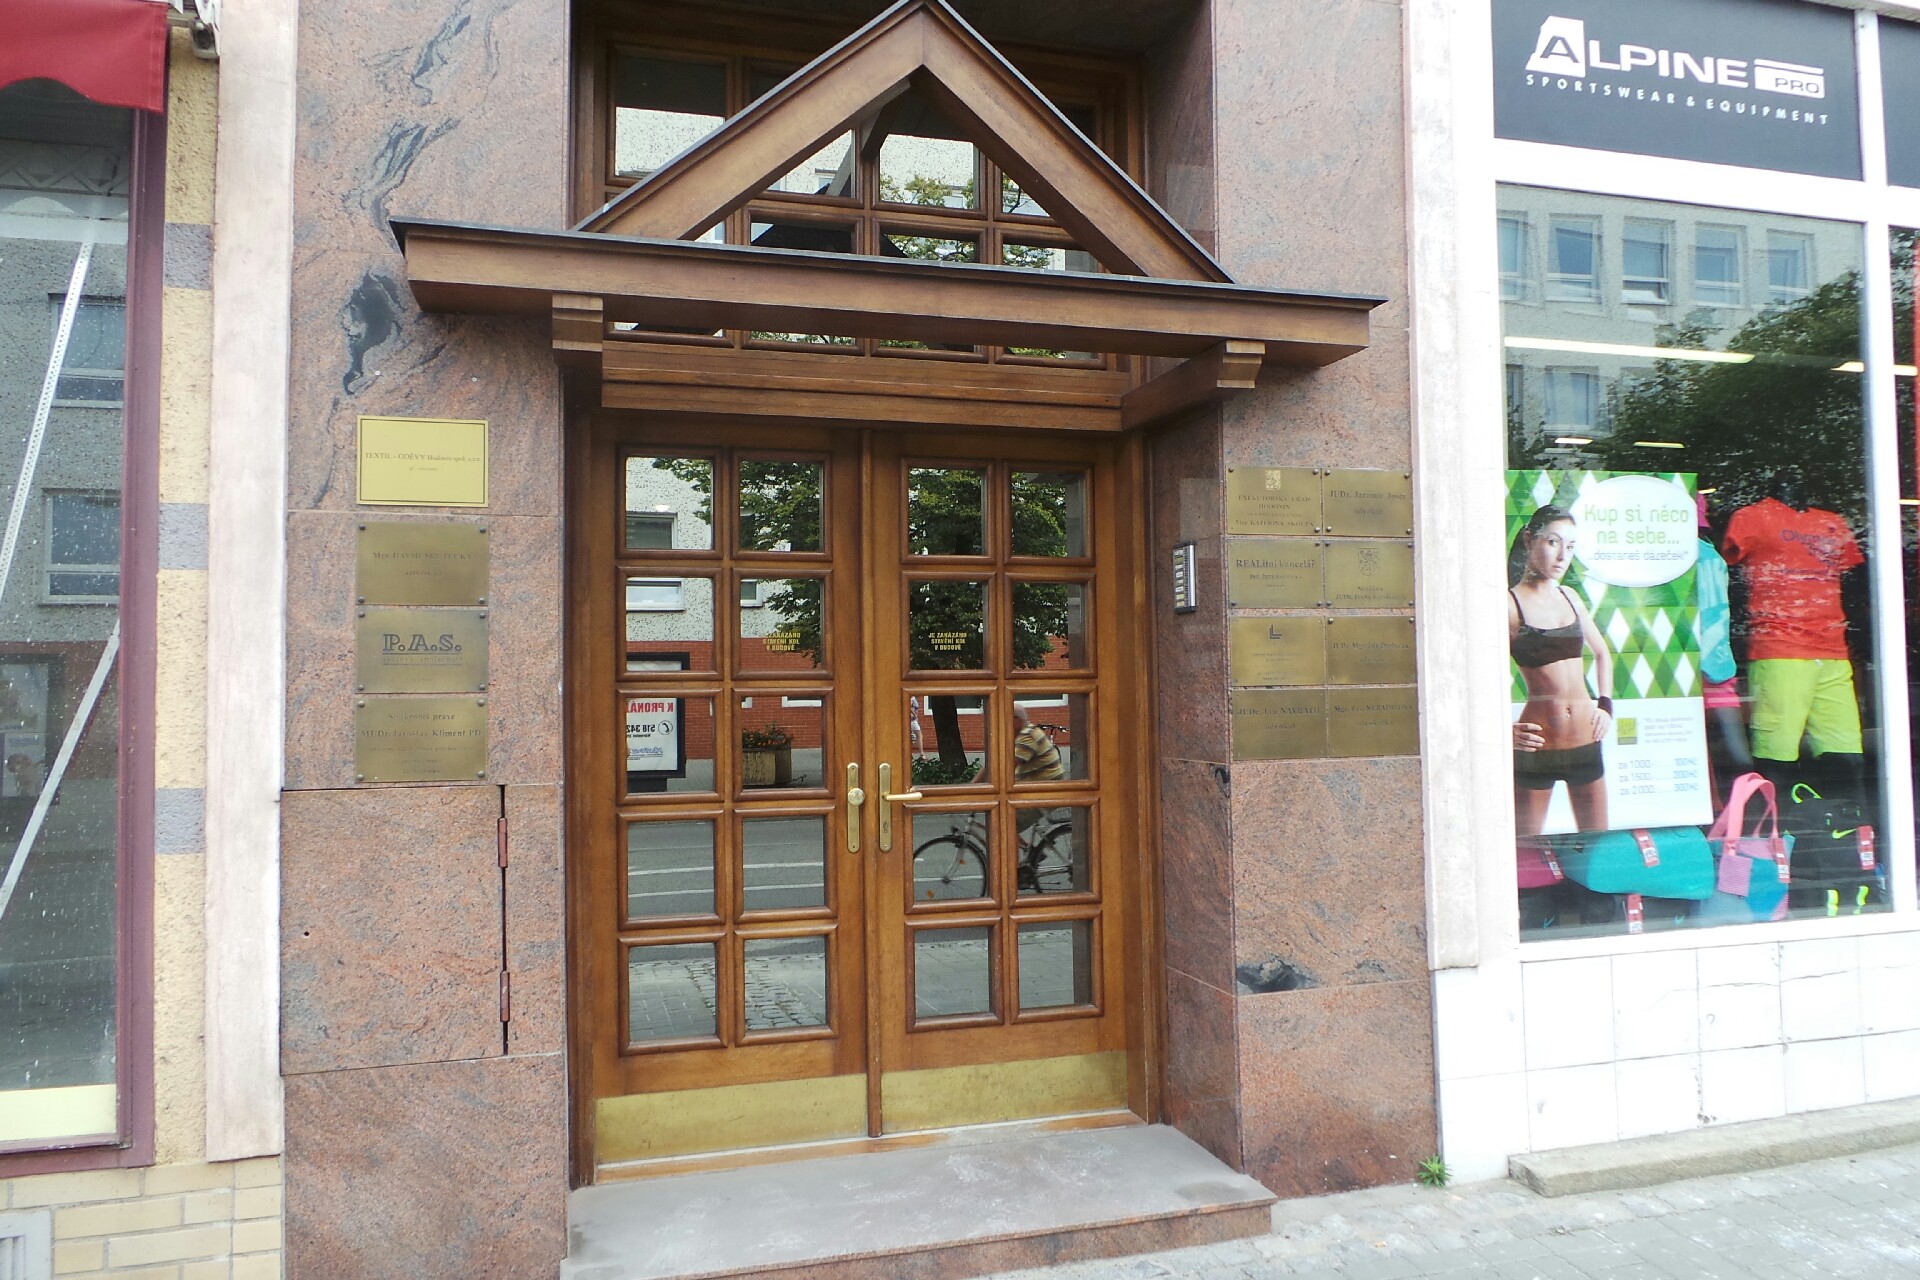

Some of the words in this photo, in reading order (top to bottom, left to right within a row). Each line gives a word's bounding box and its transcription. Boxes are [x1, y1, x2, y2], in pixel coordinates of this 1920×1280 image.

[1525, 15, 1748, 88] ALPINE
[1775, 77, 1820, 94] PRO
[1526, 74, 1675, 104] SPORTSWEAR
[1686, 95, 1696, 107] &
[1705, 98, 1830, 125] EQUIPMENT
[1584, 504, 1618, 526] Kup
[1625, 504, 1643, 523] si
[1649, 504, 1689, 523] něco
[1597, 530, 1618, 544] na
[1626, 526, 1680, 545] sebe...
[382, 634, 462, 651] P.A.S.
